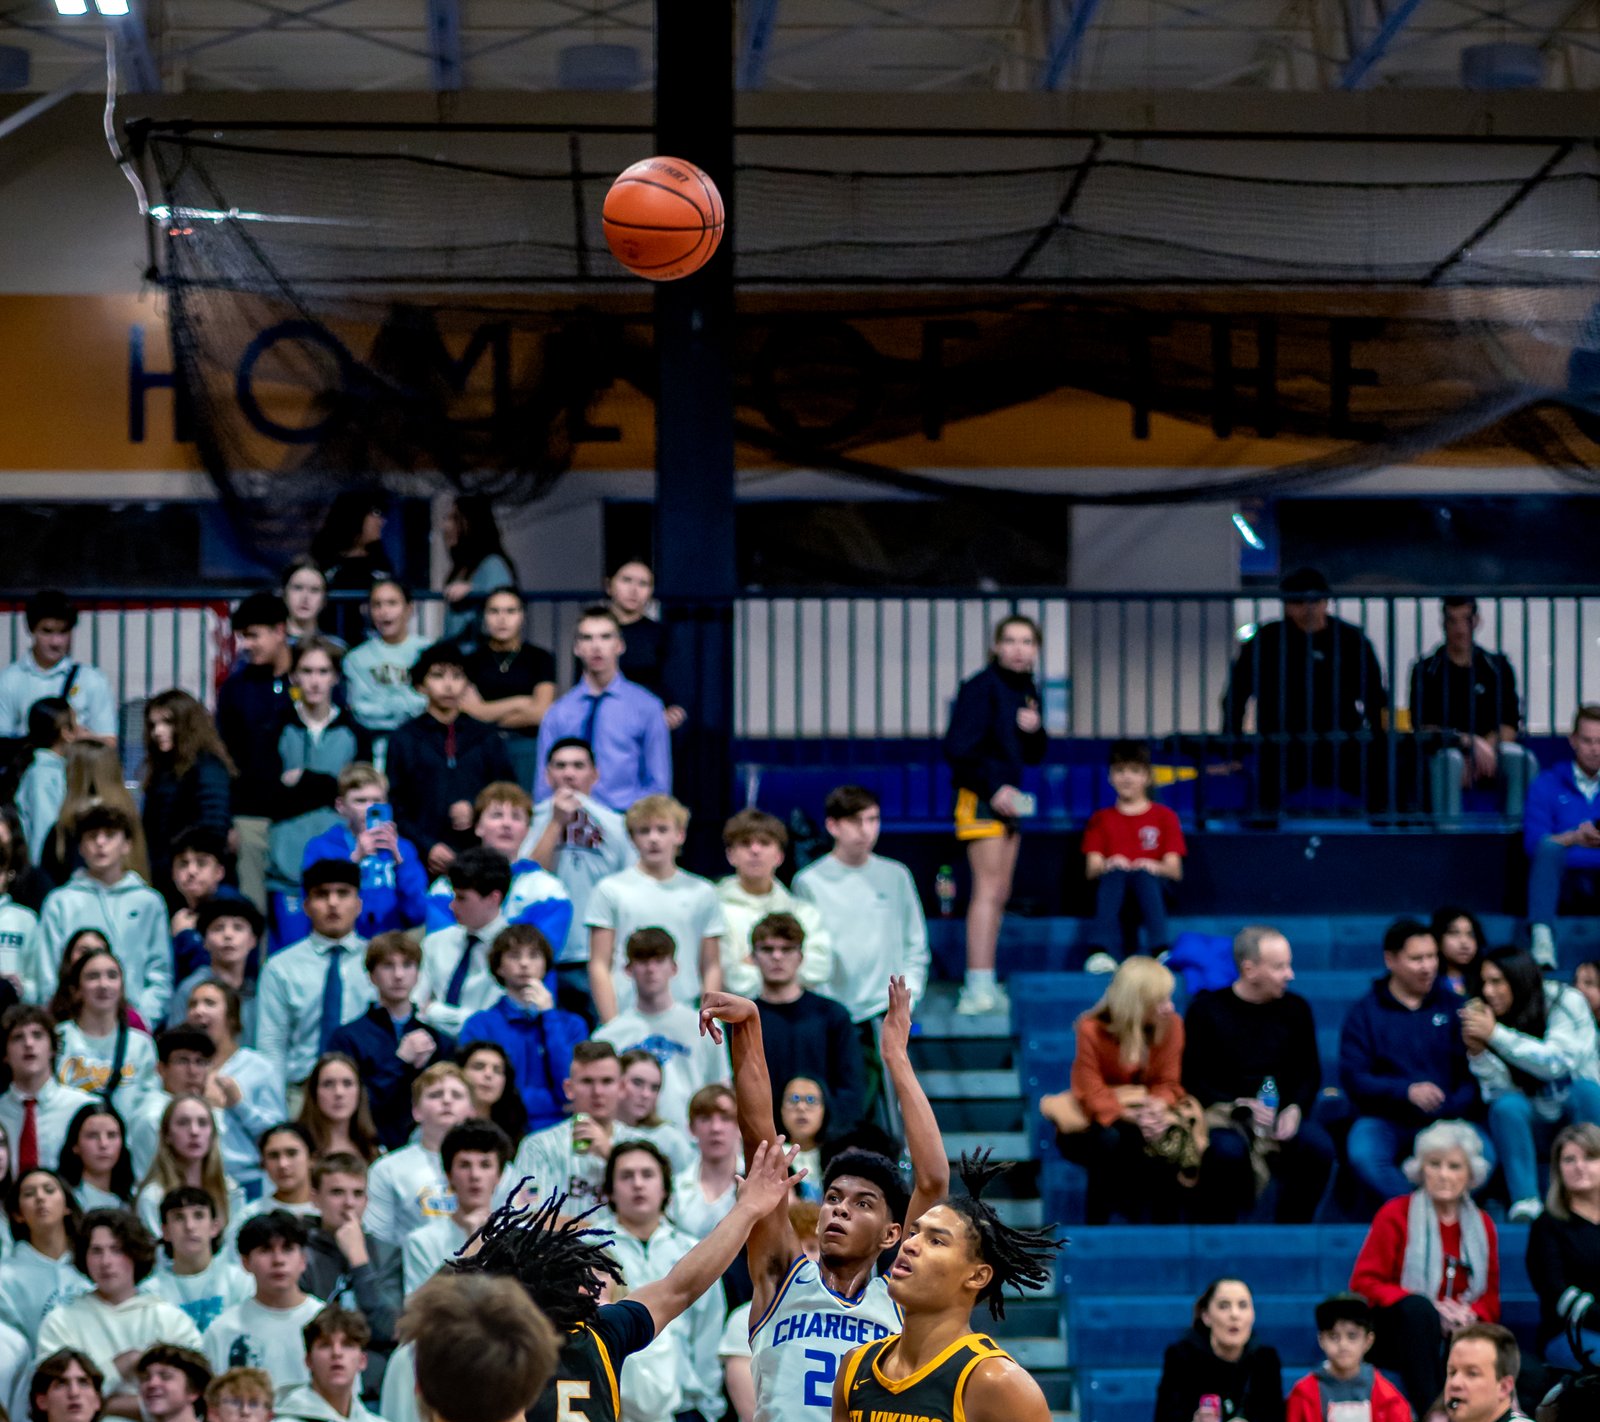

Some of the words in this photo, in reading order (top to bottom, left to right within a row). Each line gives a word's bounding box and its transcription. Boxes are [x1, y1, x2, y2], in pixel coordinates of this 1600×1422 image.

[129, 321, 622, 443] HOM
[753, 318, 981, 445] OF
[1106, 316, 1382, 441] THE
[772, 1312, 896, 1347] CHARGER
[804, 1348, 847, 1408] 2
